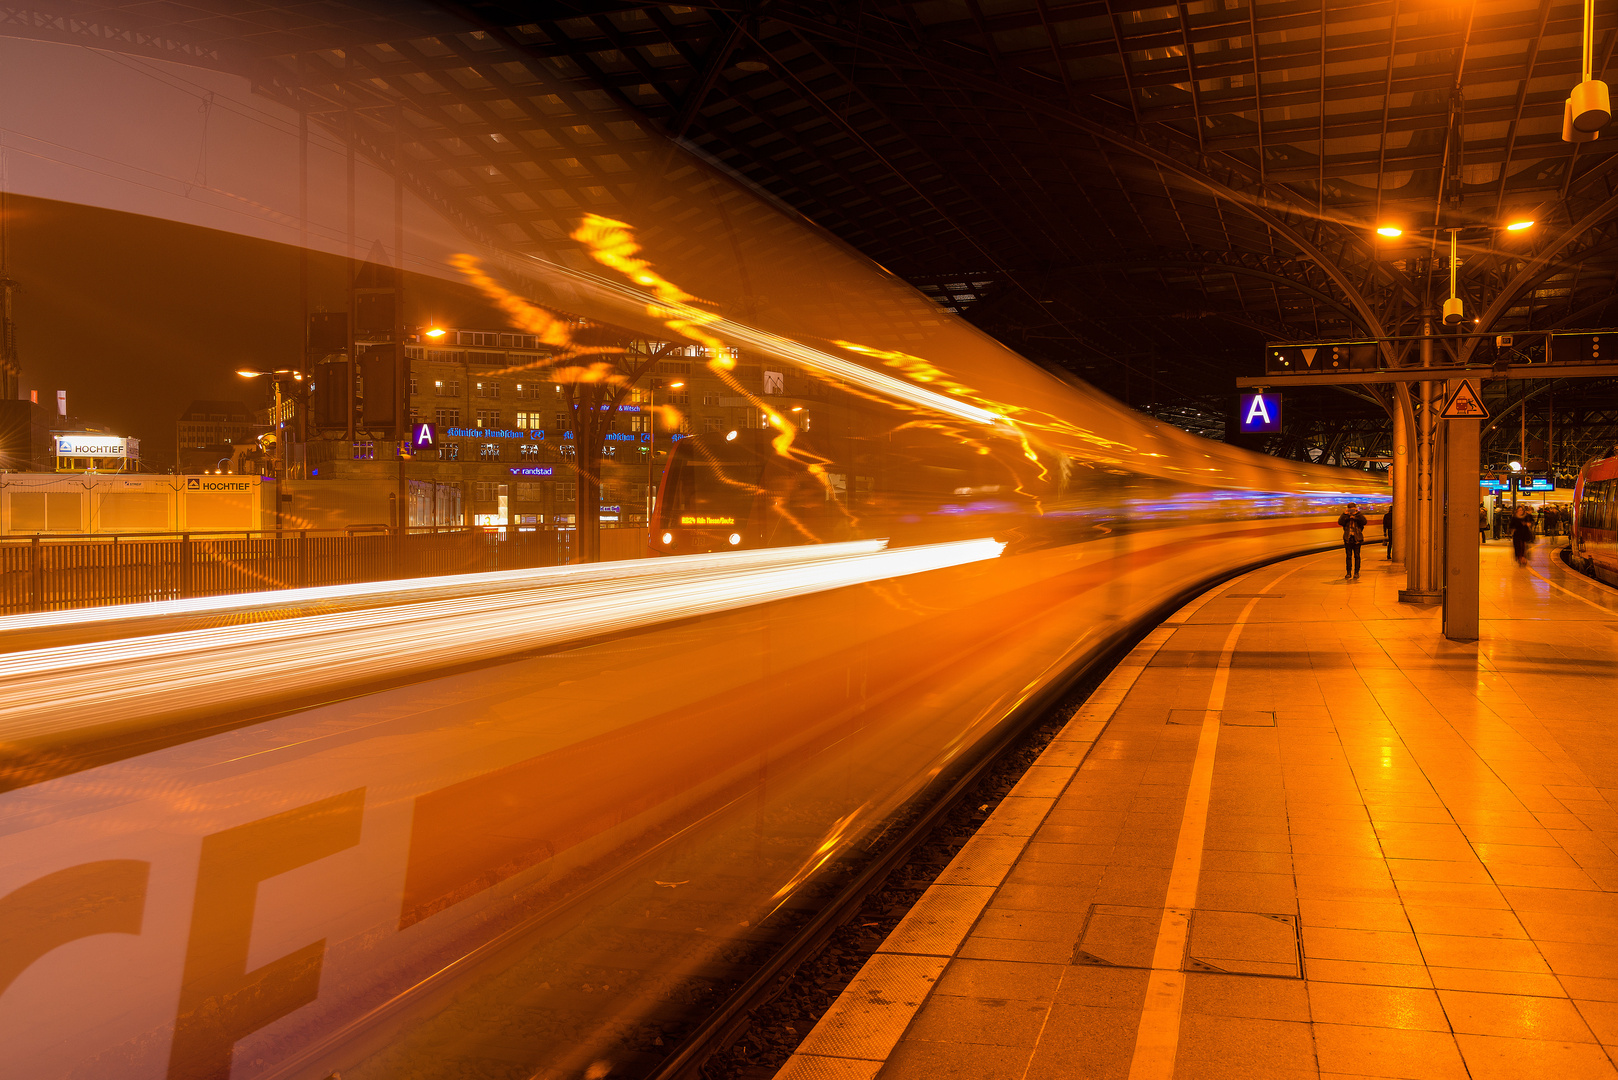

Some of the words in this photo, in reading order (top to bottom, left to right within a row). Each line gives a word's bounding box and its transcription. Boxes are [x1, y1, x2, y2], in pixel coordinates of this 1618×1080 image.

[1245, 394, 1271, 424] A
[418, 423, 433, 445] A
[75, 445, 124, 454] HOCHTIEF
[522, 466, 552, 475] randstad
[1524, 476, 1532, 486] B
[203, 482, 250, 491] HOCHTIEF
